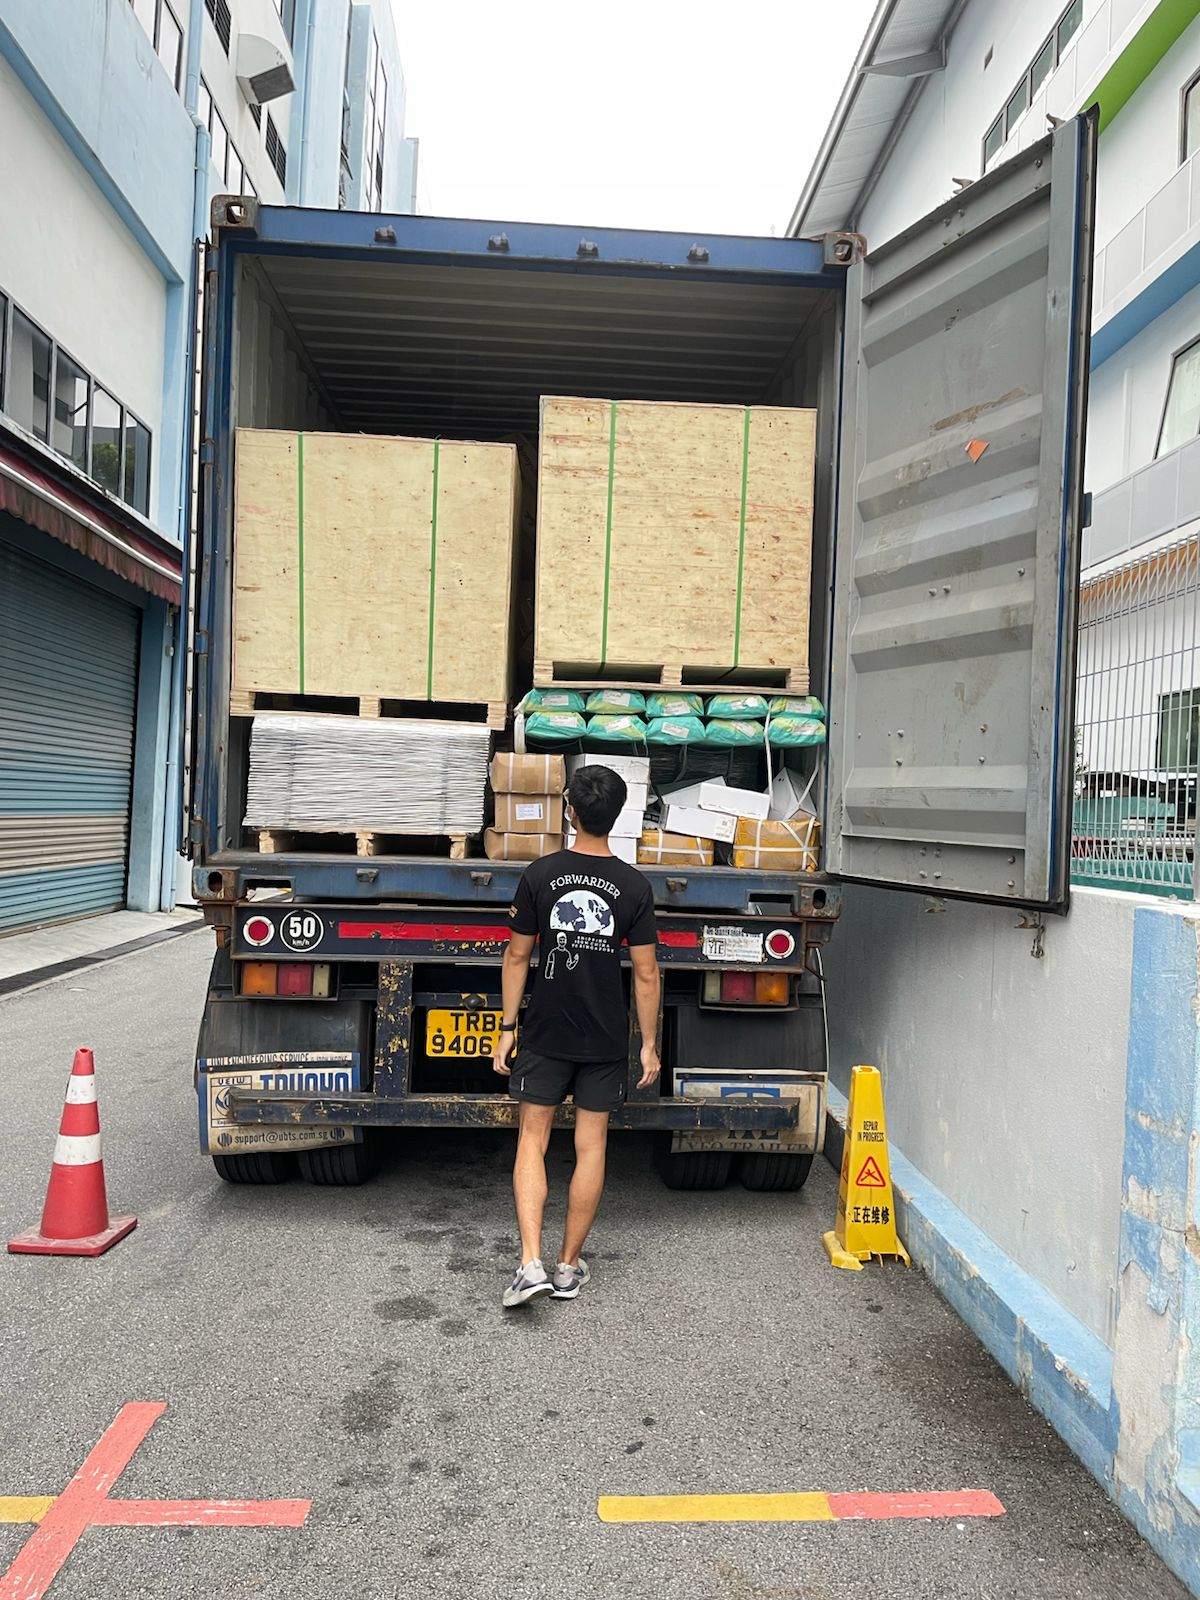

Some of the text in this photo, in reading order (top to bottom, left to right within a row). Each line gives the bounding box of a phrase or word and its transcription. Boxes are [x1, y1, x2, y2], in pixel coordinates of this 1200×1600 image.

[549, 874, 621, 899] FORWARDIER
[289, 916, 316, 938] 50
[450, 1012, 496, 1032] TRB
[432, 1034, 502, 1055] 9406
[863, 1121, 878, 1130] REPAIR
[234, 1131, 329, 1144] support@ubts.com.sg
[857, 1132, 884, 1142] IN PROGRESS
[853, 1206, 890, 1224] 正在维修
